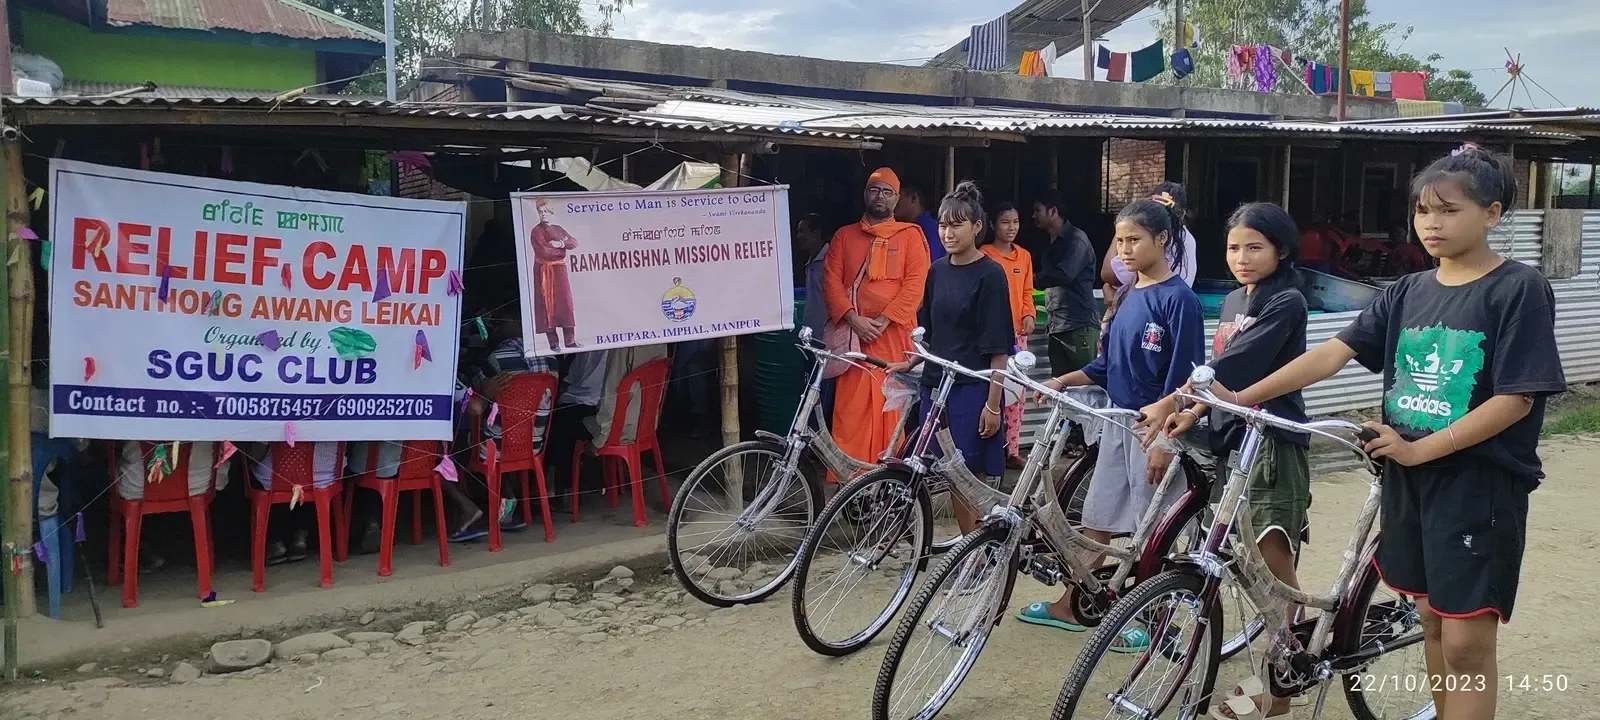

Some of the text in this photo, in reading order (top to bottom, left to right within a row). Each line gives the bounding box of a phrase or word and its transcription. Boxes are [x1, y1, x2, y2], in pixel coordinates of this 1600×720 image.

[567, 192, 766, 214] Service to Man is Service to God
[72, 217, 447, 294] RELIEF CAMP
[570, 240, 774, 273] RAMAKRISHNA MISSION RELIEF
[73, 280, 441, 326] SANTHONG AWANG LEIKAI
[204, 326, 298, 350] Organed
[300, 331, 323, 354] by
[711, 319, 761, 333] MANIPUR
[146, 349, 378, 385] SGUC CLUB
[69, 390, 146, 413] Contact
[156, 399, 184, 414] no.
[215, 396, 433, 416] 7005875457/6909252705
[1397, 393, 1452, 417] adidas
